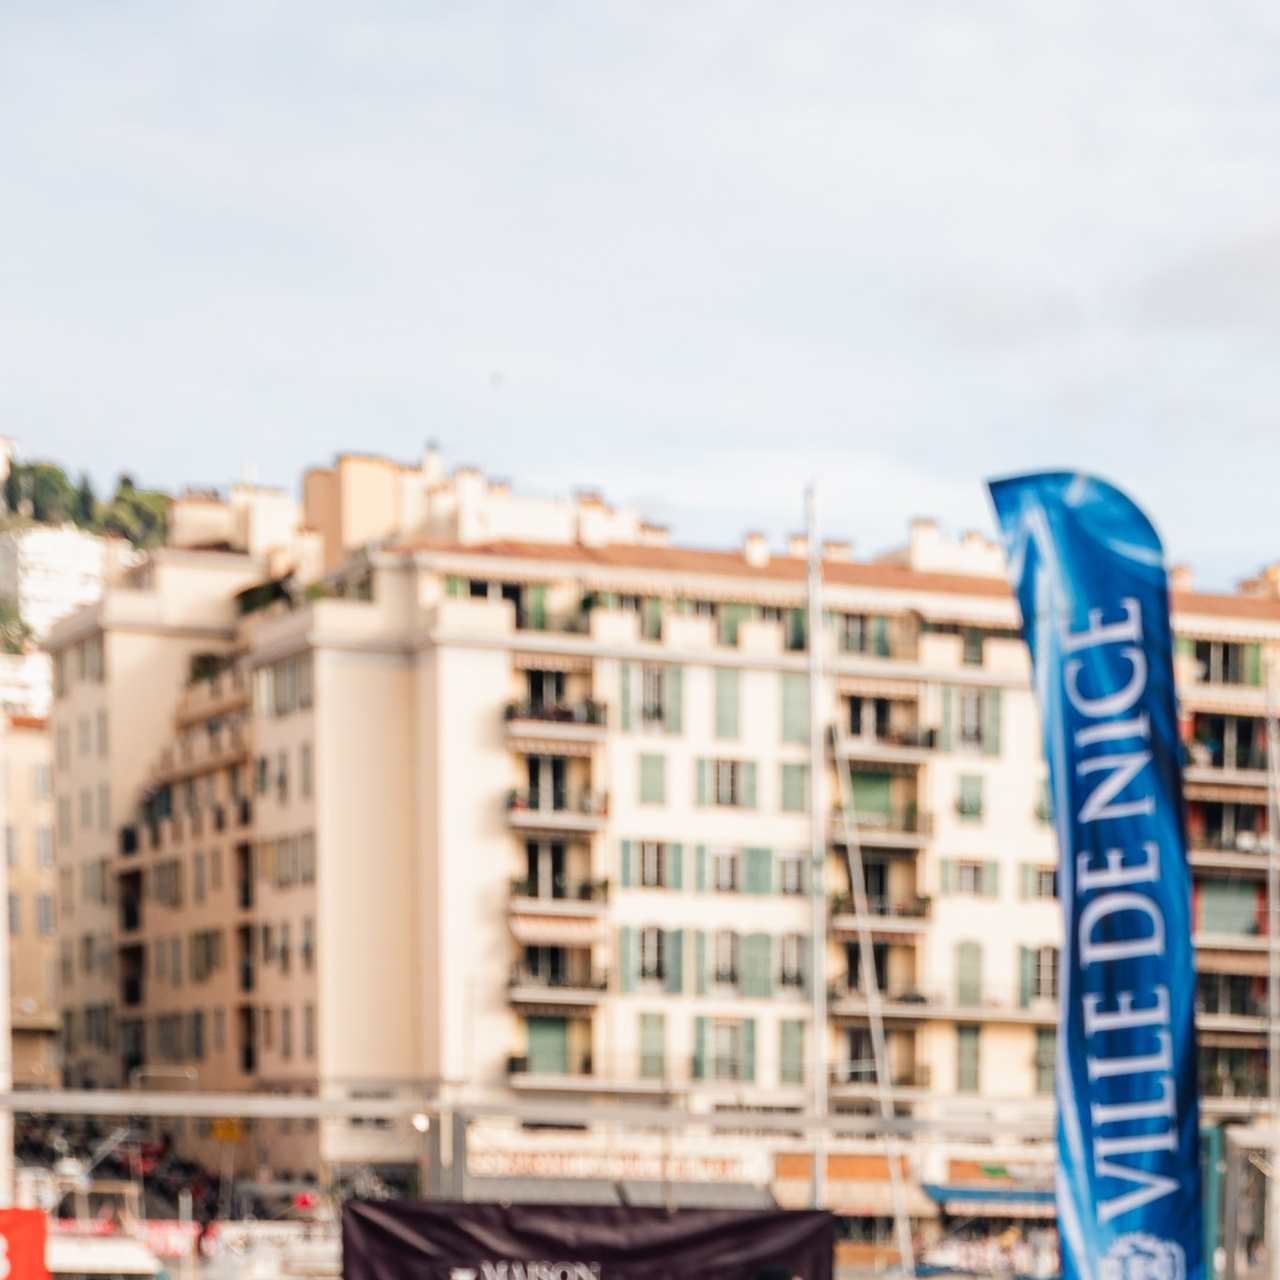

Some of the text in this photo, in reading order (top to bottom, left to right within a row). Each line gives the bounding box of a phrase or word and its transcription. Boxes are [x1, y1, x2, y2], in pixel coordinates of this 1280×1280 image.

[1061, 596, 1180, 1222] VILLE DE NICE
